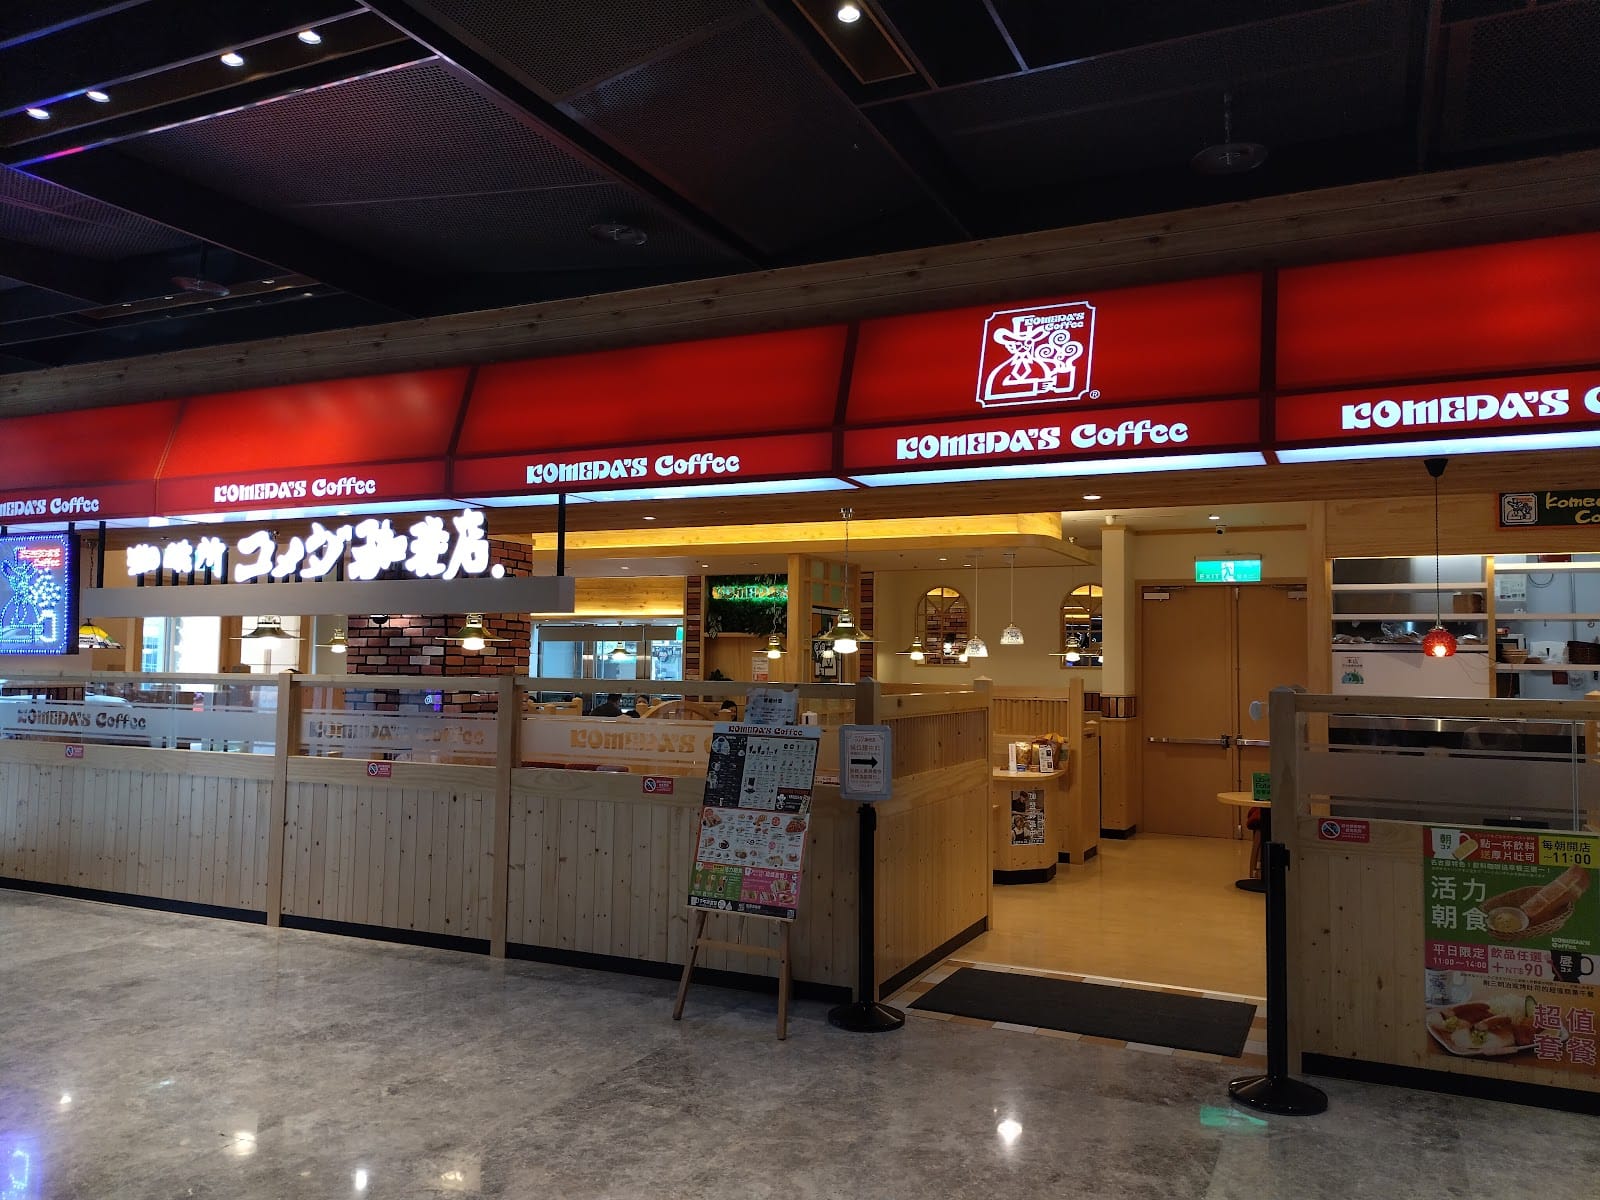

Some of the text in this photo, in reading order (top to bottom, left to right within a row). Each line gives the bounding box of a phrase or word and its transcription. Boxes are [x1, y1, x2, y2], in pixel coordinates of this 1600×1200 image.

[1341, 388, 1569, 430] KOMEDA'S
[896, 419, 1188, 460] KOMEDA'S Coffee
[526, 453, 740, 484] KOMEDA'S Coffee
[214, 476, 377, 503] KOMEDA'S Coffee
[50, 496, 99, 514] Coffee
[17, 708, 147, 730] KOMEDA'S Coffee
[774, 727, 805, 737] Coffee
[570, 728, 696, 754] KOMEDA'S
[1431, 874, 1487, 902] 活力
[1431, 904, 1489, 932] 朝食
[1432, 943, 1486, 960] 平日限定
[1532, 1003, 1596, 1037] 超值
[1533, 1033, 1597, 1067] 套餐
